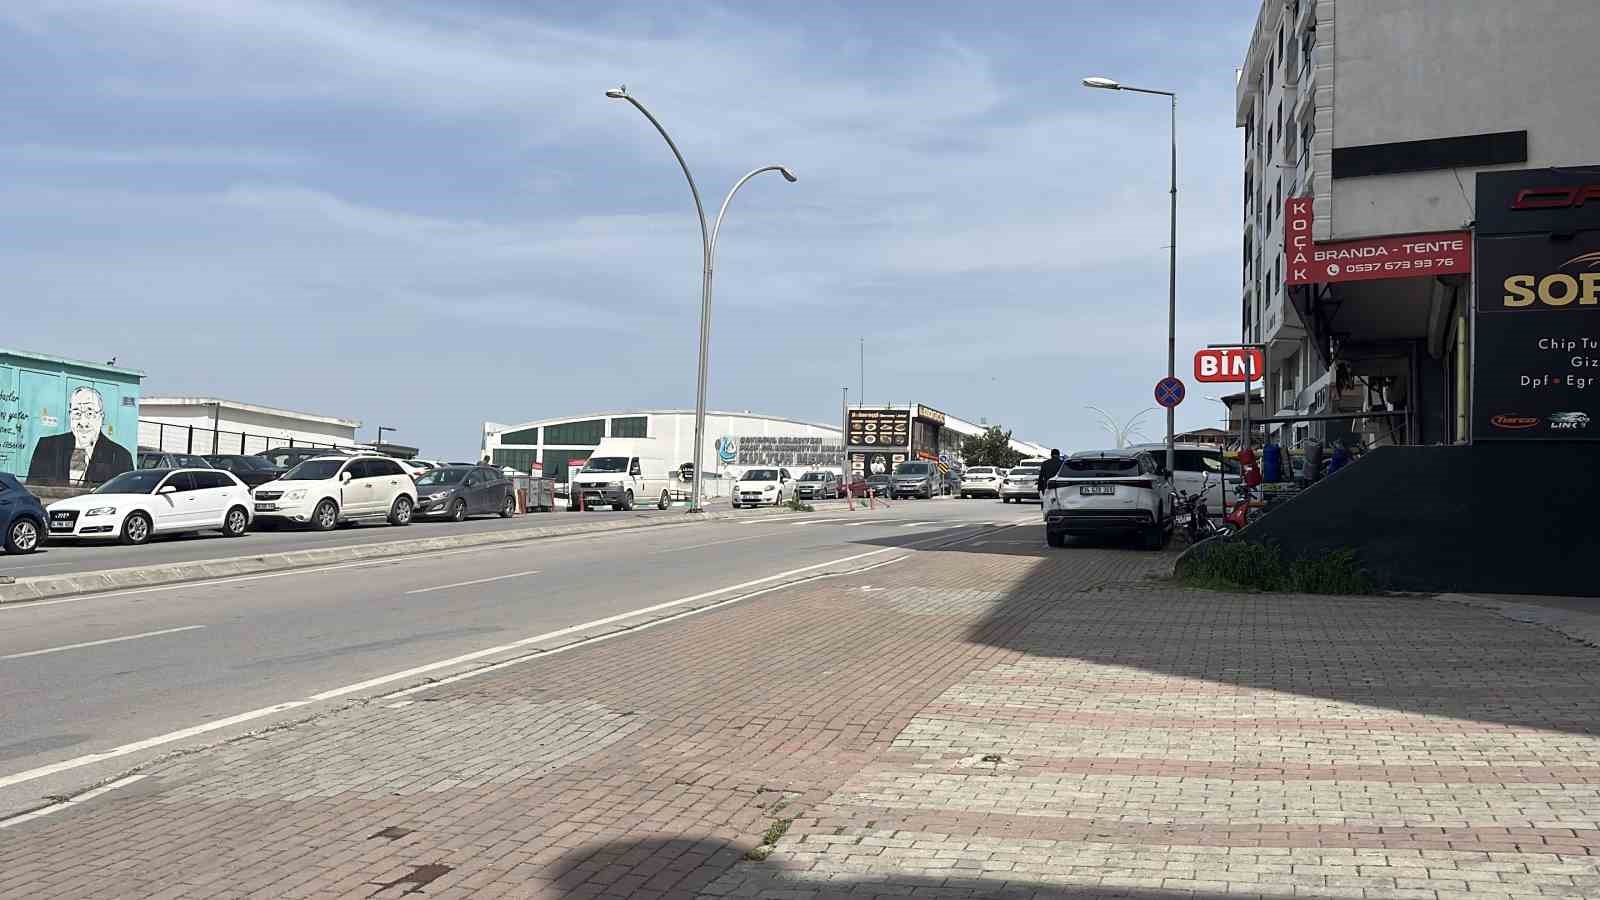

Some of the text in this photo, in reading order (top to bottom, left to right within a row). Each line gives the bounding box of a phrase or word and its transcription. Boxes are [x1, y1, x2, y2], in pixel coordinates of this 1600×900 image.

[1292, 203, 1307, 280] KOÇAK
[1314, 246, 1389, 261] BRANDA
[1402, 240, 1464, 254] TENTE
[1346, 258, 1454, 274] 0537 673 93 76
[1538, 338, 1576, 352] Chip
[1200, 350, 1256, 376] BİM
[1520, 374, 1593, 389] Dpf Egr
